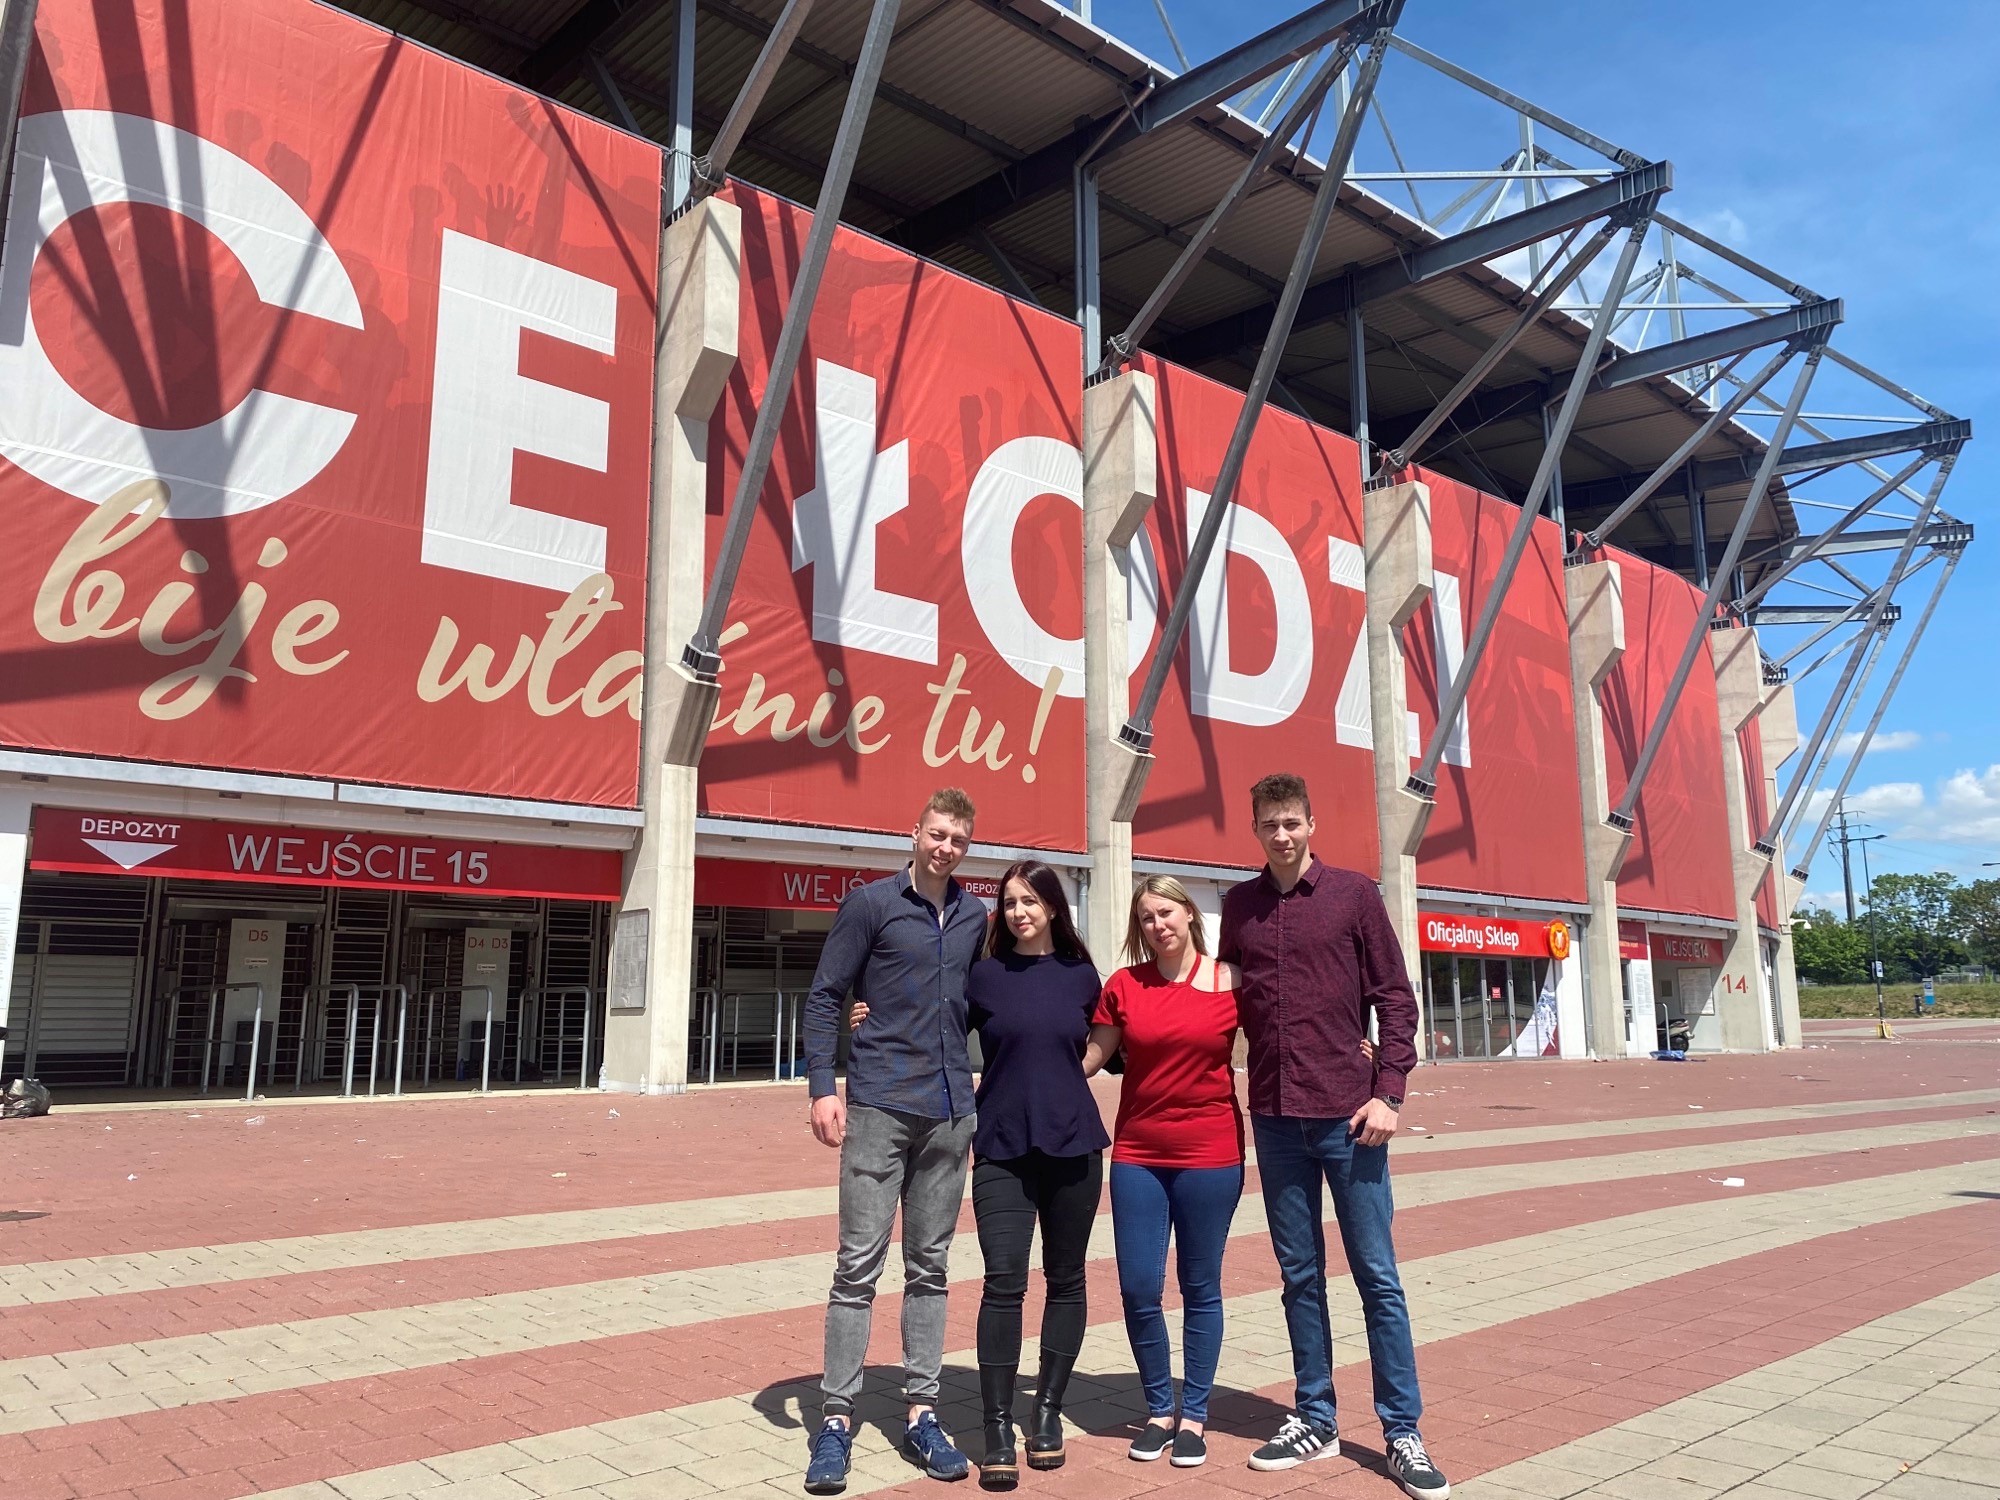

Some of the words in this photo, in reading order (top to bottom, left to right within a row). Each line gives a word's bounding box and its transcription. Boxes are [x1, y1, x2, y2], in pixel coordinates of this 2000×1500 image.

[33, 478, 350, 720] bije
[922, 653, 1064, 783] tu!
[81, 818, 181, 839] DEPOZYT
[227, 833, 436, 882] WEJŚCIE
[446, 850, 488, 885] 15
[783, 871, 867, 904] WEJŚ
[965, 882, 999, 895] DEPOZ
[248, 929, 269, 942] D5
[491, 937, 508, 949] D3
[1427, 920, 1484, 949] Oficjalny
[1485, 925, 1520, 951] Sklep
[1721, 973, 1747, 994] 14
